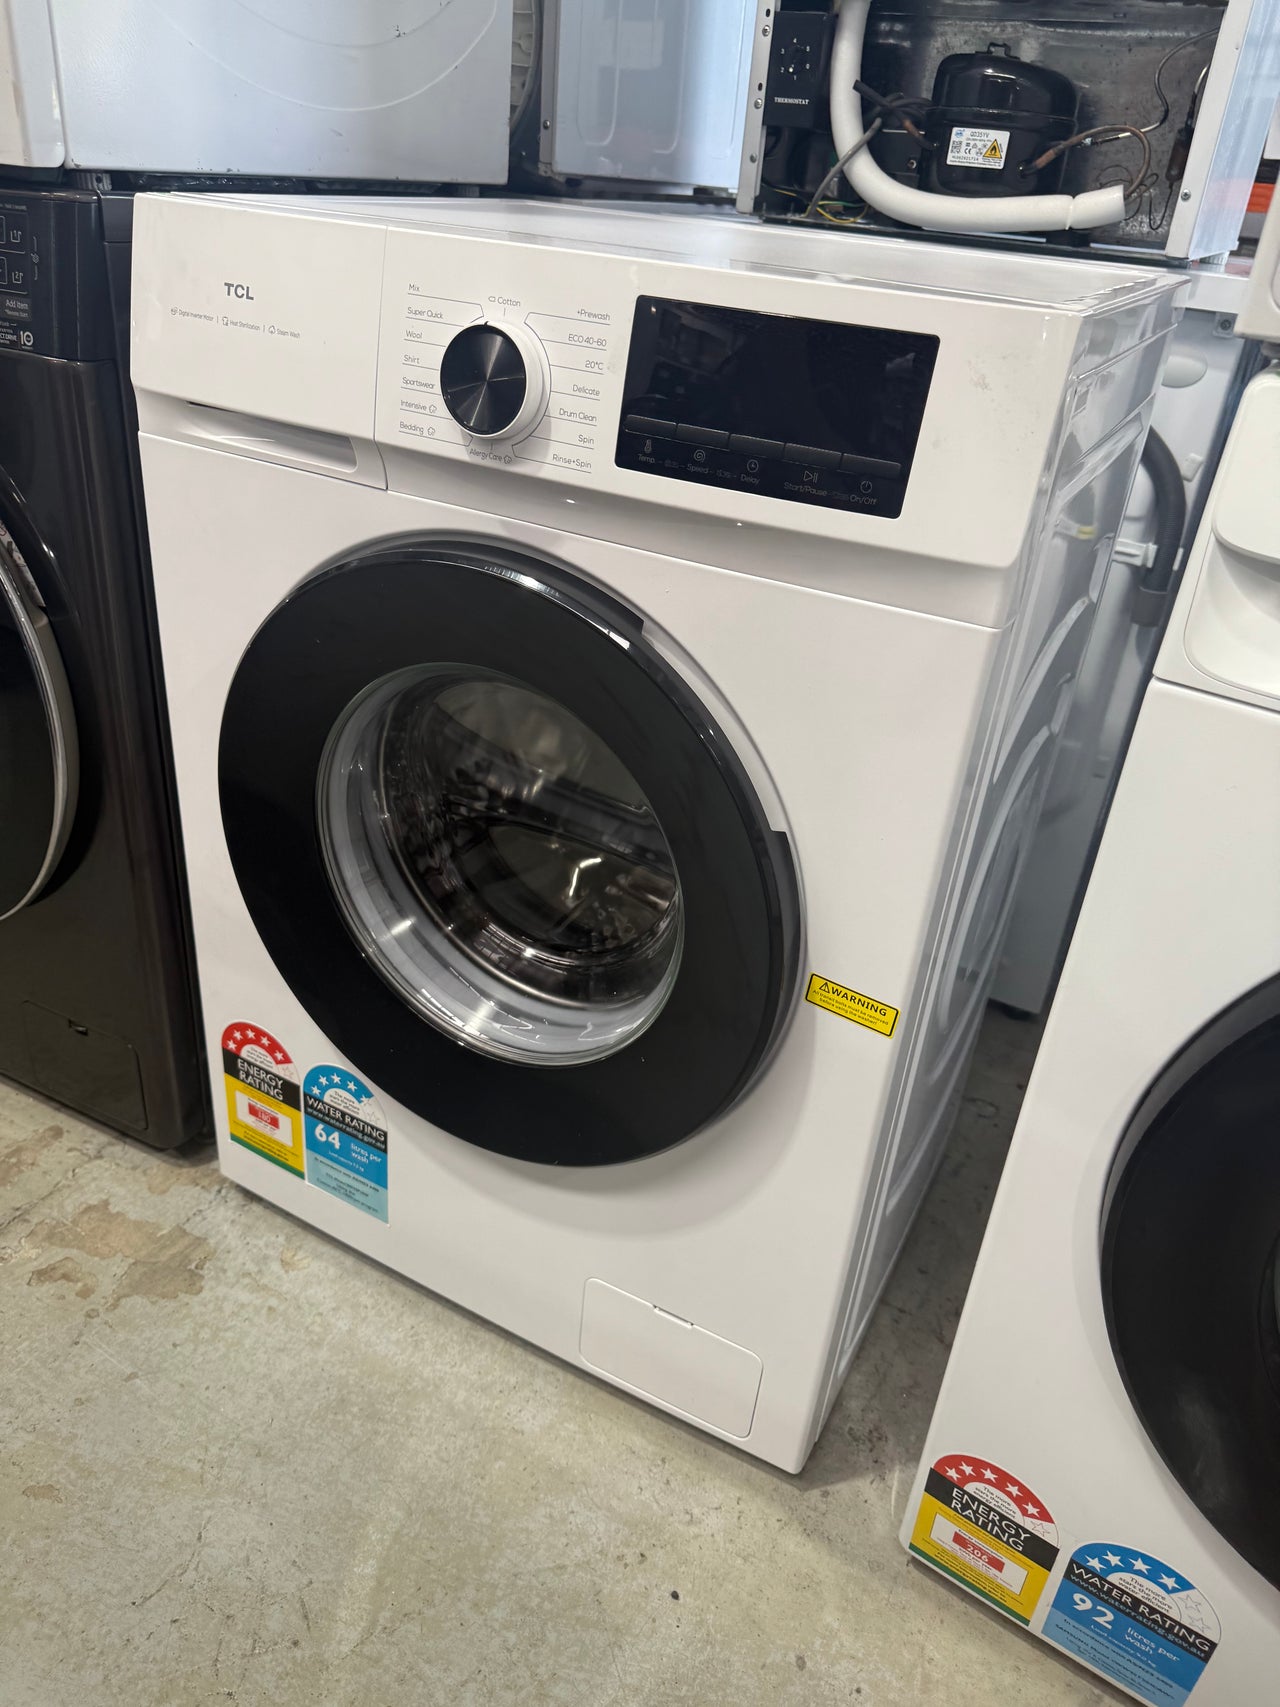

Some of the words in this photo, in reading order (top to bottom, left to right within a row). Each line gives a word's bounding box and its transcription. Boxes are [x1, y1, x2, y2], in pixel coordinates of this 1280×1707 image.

[774, 97, 810, 105] THERMOSTAT
[224, 282, 254, 301] TCL
[408, 284, 420, 292] Mix
[497, 296, 521, 307] Cotton
[407, 307, 426, 316] Super
[426, 310, 444, 319] Quick
[20, 330, 34, 346] 10
[405, 330, 422, 338] Wool
[568, 333, 584, 343] ECO
[584, 337, 607, 347] 40-60
[404, 354, 420, 364] Shirt
[402, 377, 435, 389] Sportswear
[572, 384, 600, 396] Delicate
[400, 400, 427, 411] Intensive
[559, 408, 577, 419] Drum
[578, 412, 597, 422] Clean
[400, 421, 424, 435] Bedding
[578, 434, 594, 445] Spin
[469, 448, 488, 459] Allergy
[488, 453, 502, 462] Care
[552, 453, 591, 469] Rinse+Spin
[686, 463, 709, 474] Speed
[741, 473, 760, 486] Delay
[783, 482, 828, 497] Start/Pause
[850, 494, 877, 505] On/Off
[831, 987, 888, 1016] WARNING
[238, 1058, 284, 1089] ENERGY
[239, 1071, 283, 1100] RATING
[306, 1095, 342, 1120] WATER
[315, 1123, 341, 1149] 64
[345, 1115, 385, 1142] RATING
[351, 1143, 369, 1156] litres
[369, 1154, 382, 1163] per
[984, 1486, 994, 1496] The
[995, 1495, 1011, 1506] more
[952, 1487, 1031, 1540] ENERGY
[951, 1499, 1024, 1551] RATING
[967, 1544, 988, 1562] 206
[1073, 1563, 1132, 1607] WATER
[1119, 1577, 1136, 1589] stars
[1138, 1588, 1150, 1596] the
[1152, 1597, 1172, 1609] more
[1130, 1576, 1143, 1587] The
[1145, 1587, 1166, 1600] more
[1119, 1582, 1140, 1595] water
[1141, 1595, 1169, 1612] efficient
[1070, 1575, 1205, 1657] www.waterrating.gov.au
[1073, 1593, 1114, 1629] 92
[1139, 1605, 1211, 1651] RATING
[1127, 1627, 1156, 1649] litres
[1158, 1647, 1180, 1661] per
